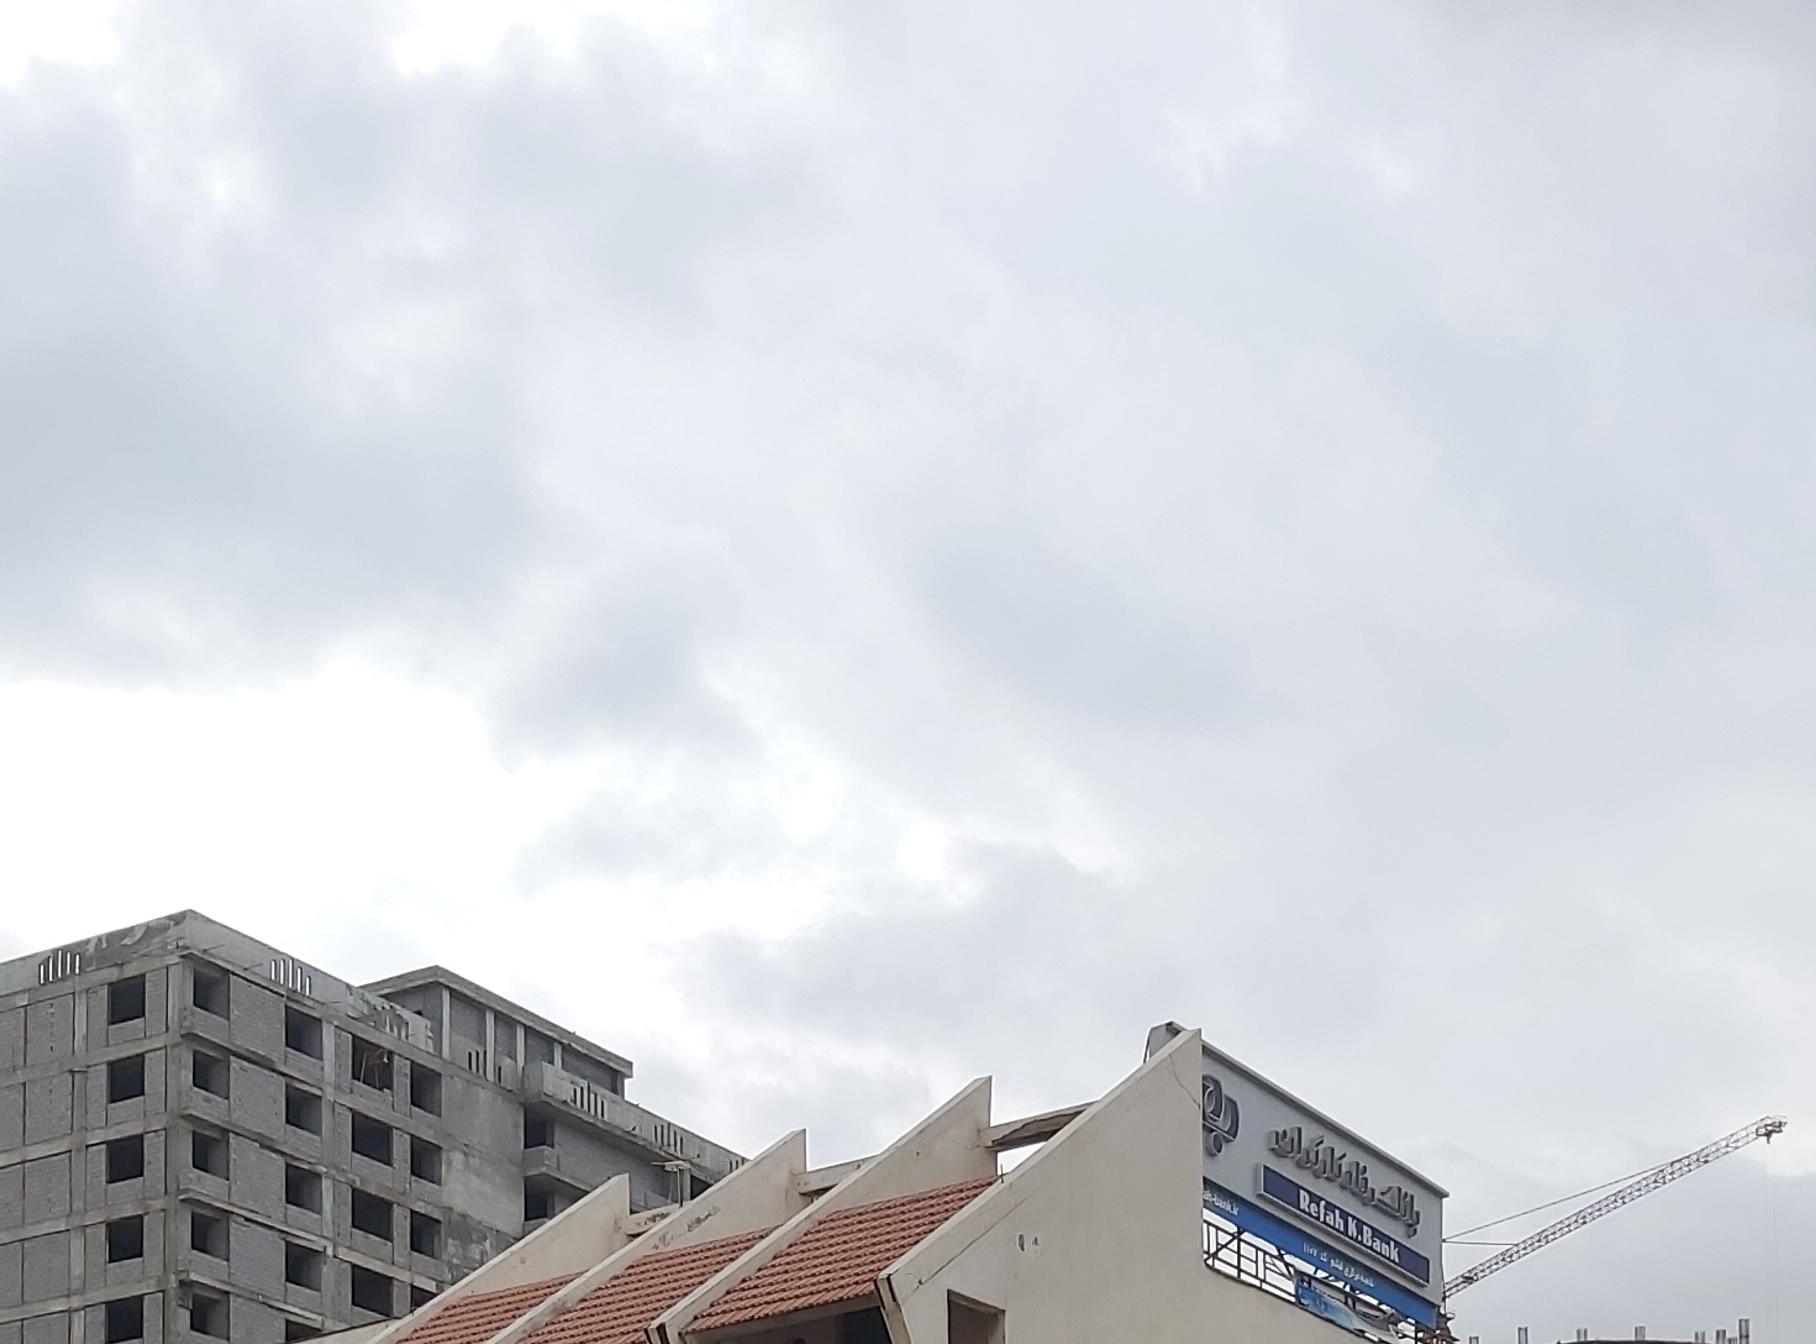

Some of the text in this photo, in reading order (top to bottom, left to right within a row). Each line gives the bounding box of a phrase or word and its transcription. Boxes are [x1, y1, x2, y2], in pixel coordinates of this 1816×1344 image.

[1268, 1126, 1421, 1239] بانک رفاه کارگران
[1299, 1188, 1400, 1264] Refah K.Bank
